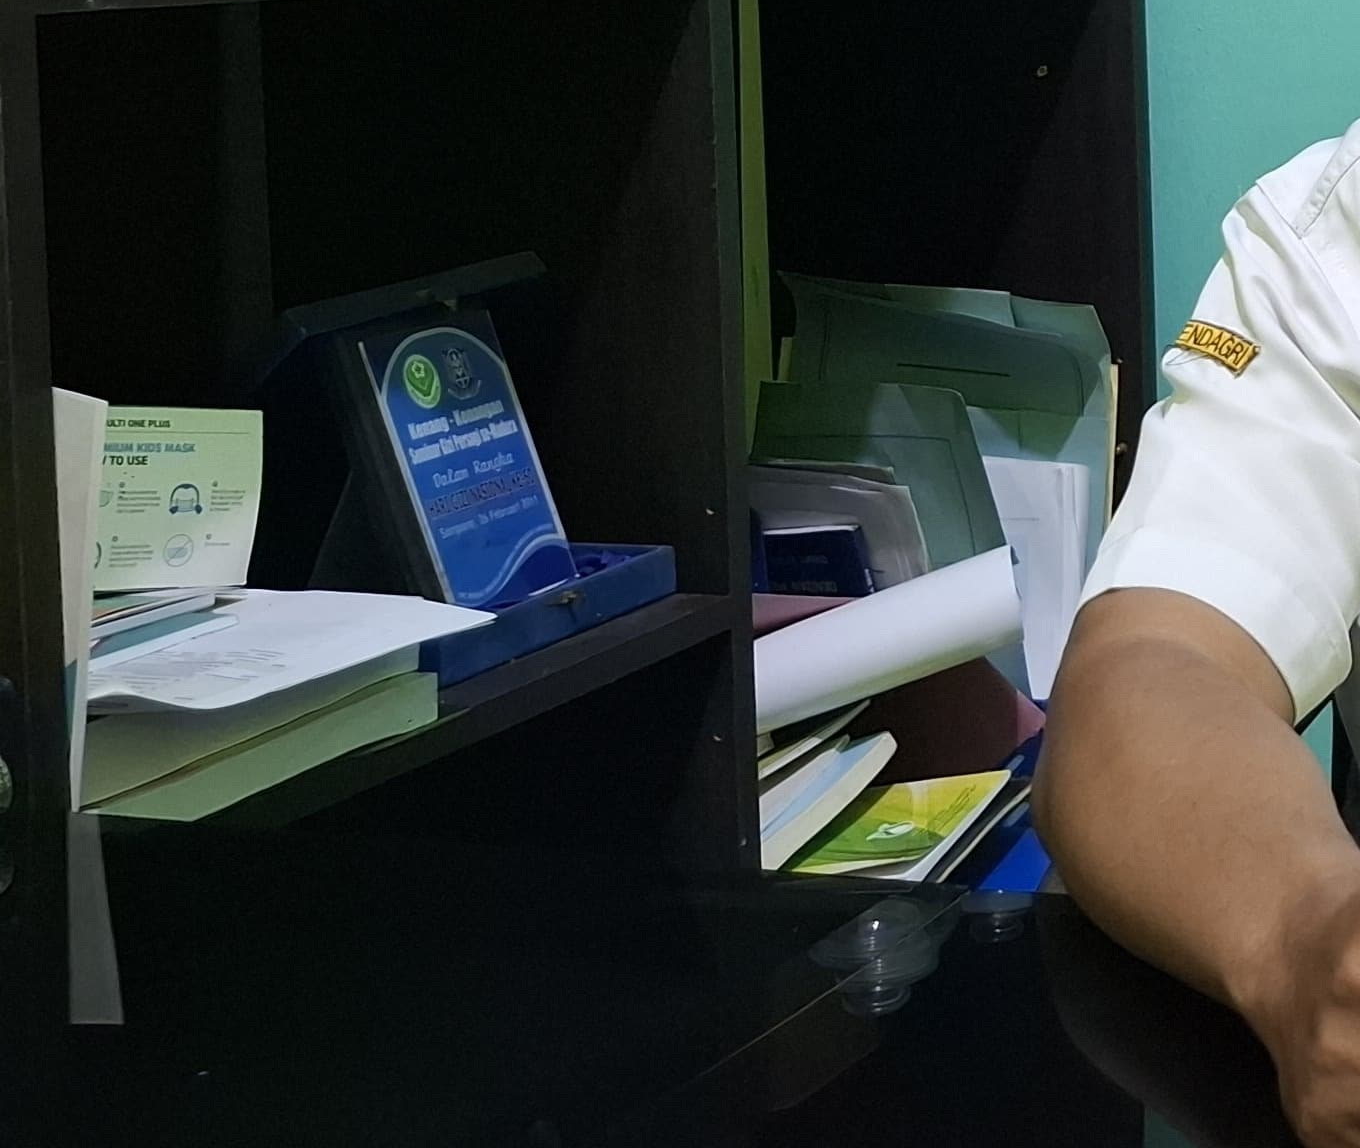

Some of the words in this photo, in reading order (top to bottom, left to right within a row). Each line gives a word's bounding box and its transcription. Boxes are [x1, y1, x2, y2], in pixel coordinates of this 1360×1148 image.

[1177, 324, 1249, 365] ENDAGRI
[106, 419, 126, 428] ULTI
[127, 419, 146, 428] ONE
[147, 419, 171, 429] PLUS
[104, 442, 134, 453] MIUM
[164, 443, 197, 453] MASK
[109, 455, 124, 466] TO
[127, 455, 149, 466] USE
